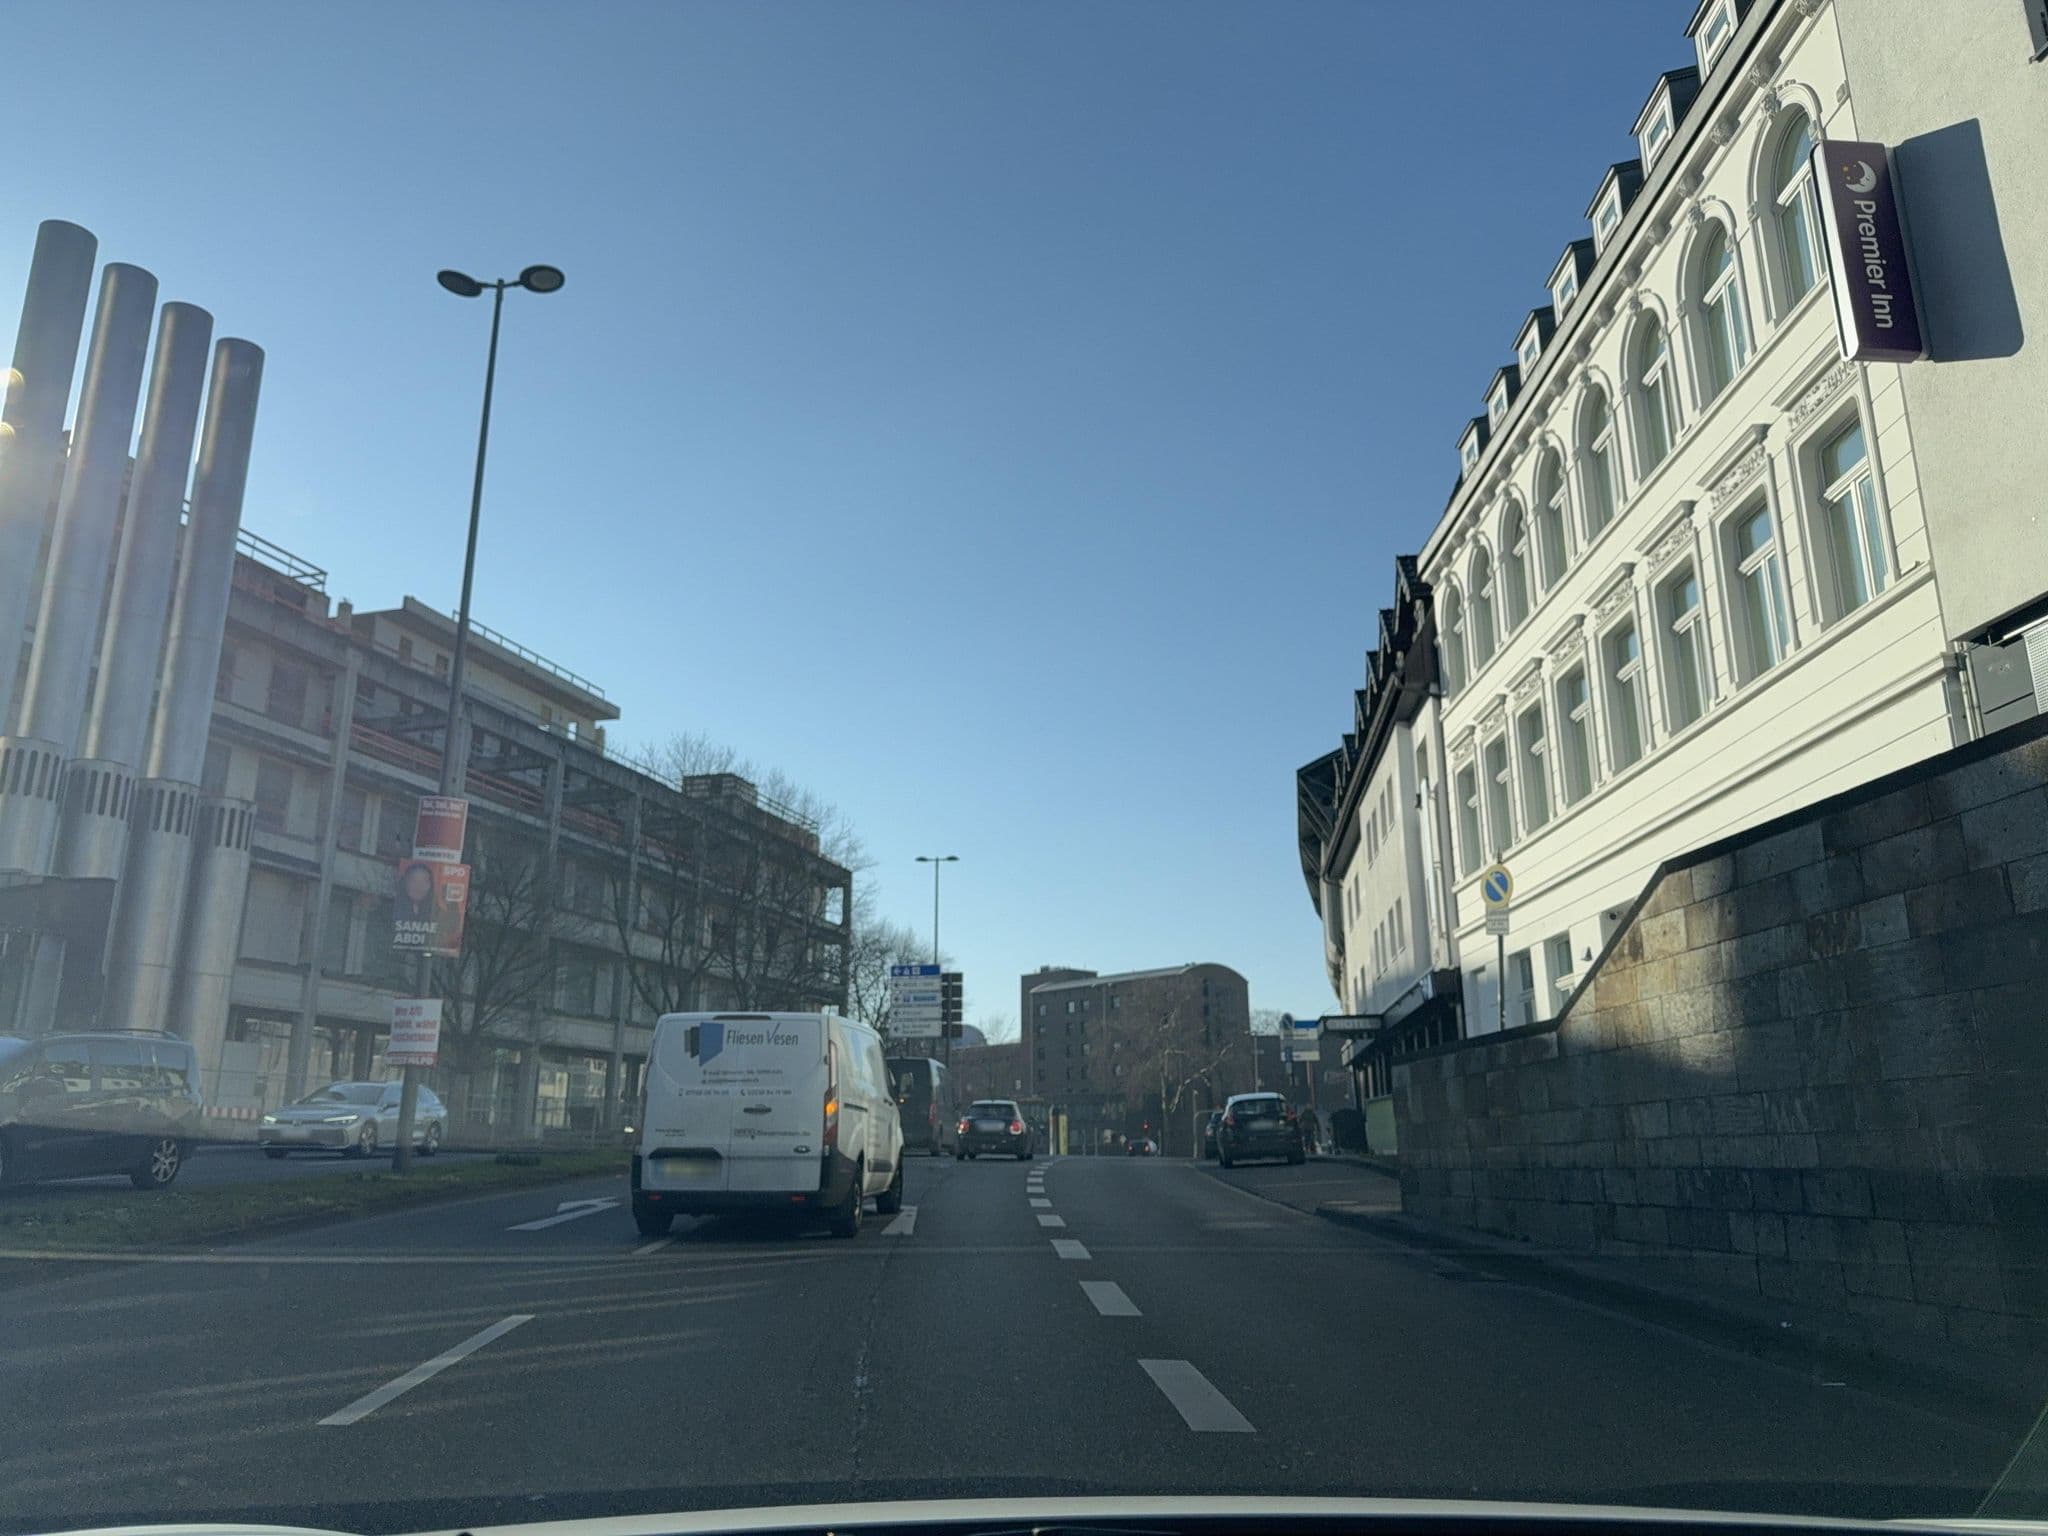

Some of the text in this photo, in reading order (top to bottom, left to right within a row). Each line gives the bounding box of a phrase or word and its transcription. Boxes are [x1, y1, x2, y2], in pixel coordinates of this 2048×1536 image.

[1853, 199, 1894, 330] Premier Inn
[443, 865, 466, 878] SPD
[394, 920, 439, 933] SANAE
[393, 933, 426, 945] ABDI
[726, 1022, 799, 1046] Fliesen Vesen
